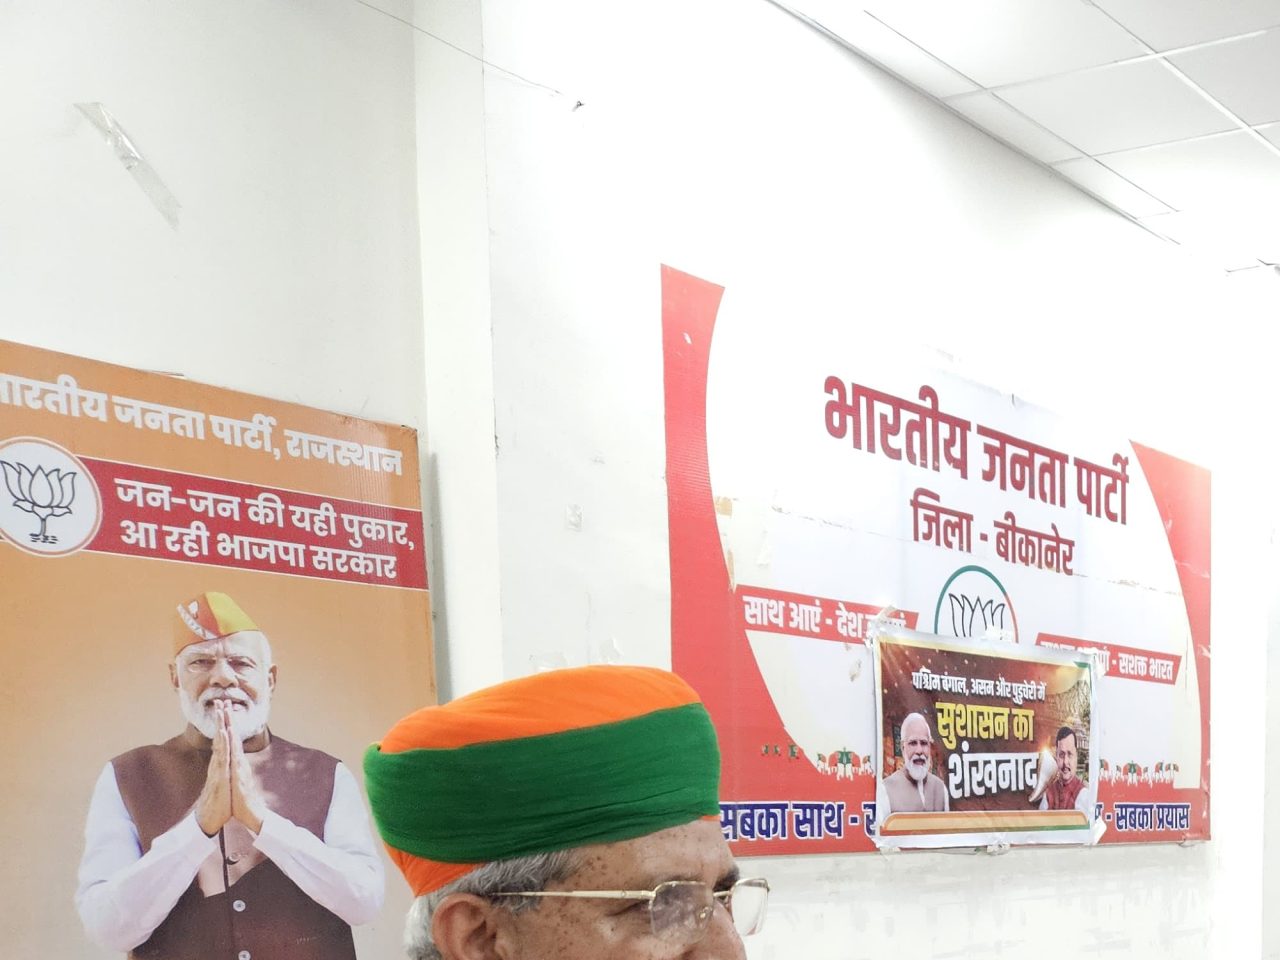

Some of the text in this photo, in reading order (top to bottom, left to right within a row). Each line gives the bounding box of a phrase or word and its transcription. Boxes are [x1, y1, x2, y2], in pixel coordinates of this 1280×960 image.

[112, 396, 205, 440] जनता
[208, 413, 282, 460] पार्टी,
[283, 429, 402, 475] राजस्थान
[824, 375, 1130, 525] भारतीय जनता पार्टी
[114, 477, 415, 551] जन-जन की यही पुकार,
[910, 487, 974, 554] जिला
[994, 511, 1075, 576] बीकानेर
[119, 518, 398, 578] आ रही भाजपा सरकार
[742, 595, 785, 628] साथ
[789, 599, 822, 633] आएं
[835, 602, 864, 638] देश
[912, 666, 1047, 704] पश्चिम बंगाल, असम और पुडुचेरी में
[1117, 652, 1148, 676] सशक्त
[1149, 657, 1174, 680] भारत
[935, 701, 1035, 749] सुशासन का
[948, 741, 1039, 799] शंखनाद
[719, 801, 789, 841] सबका
[791, 801, 845, 840] साथ
[1114, 802, 1154, 831] सबका
[1154, 803, 1191, 831] प्रयास
